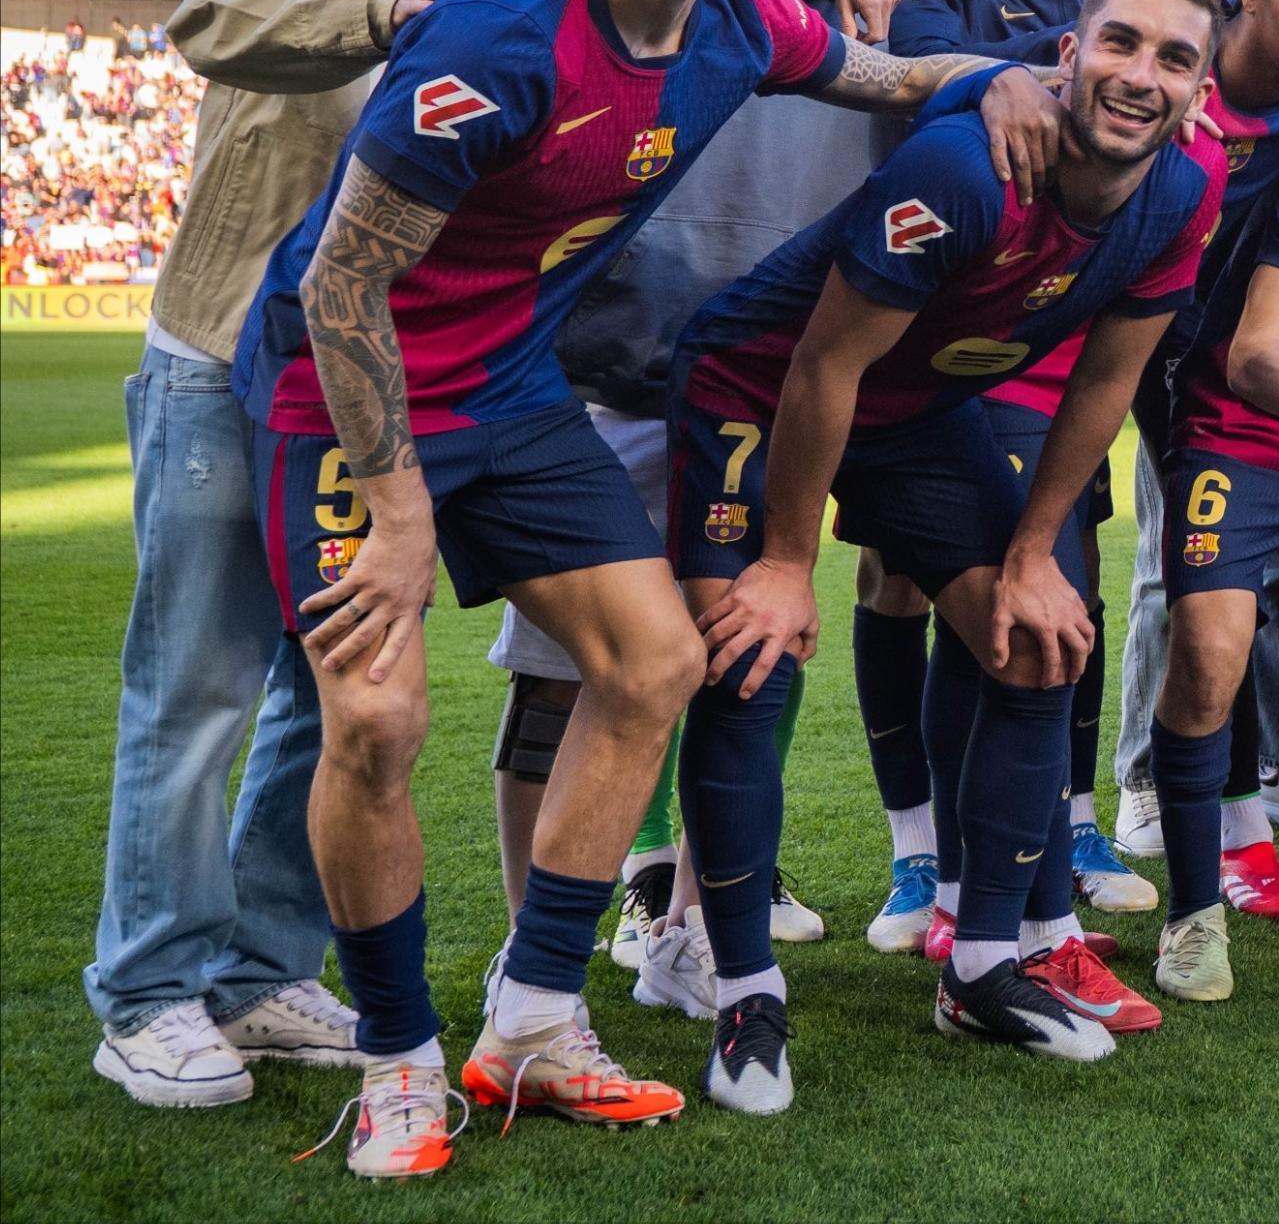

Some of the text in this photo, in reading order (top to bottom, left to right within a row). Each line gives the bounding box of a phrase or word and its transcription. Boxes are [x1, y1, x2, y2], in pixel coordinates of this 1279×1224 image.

[315, 447, 368, 532] 5
[718, 421, 762, 494] 7
[1187, 469, 1232, 526] 6
